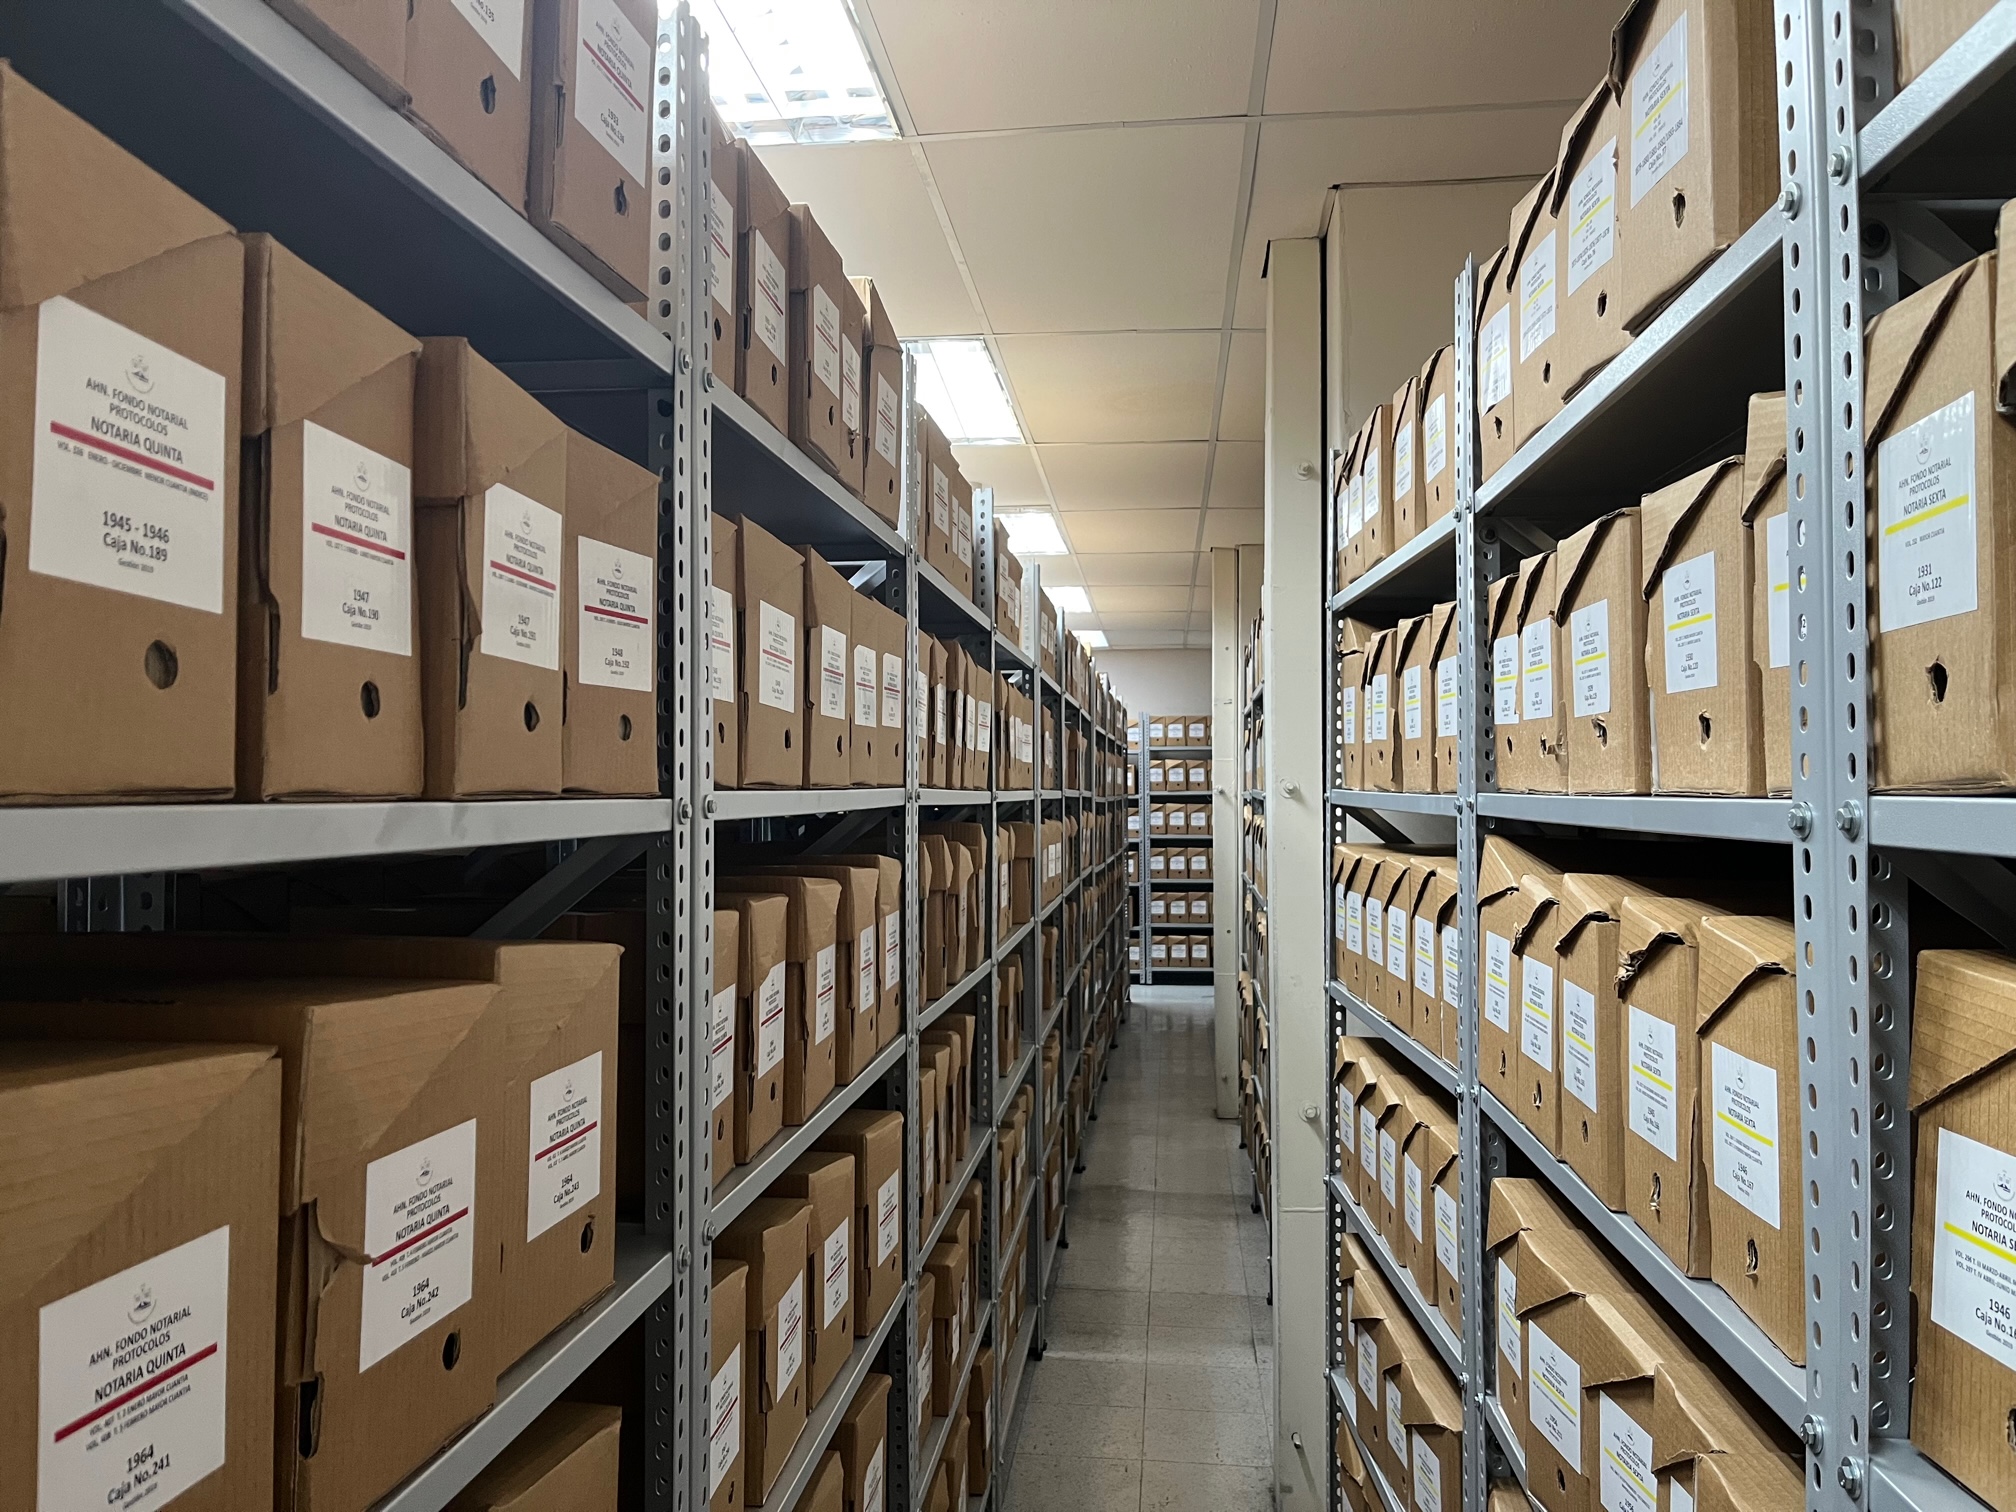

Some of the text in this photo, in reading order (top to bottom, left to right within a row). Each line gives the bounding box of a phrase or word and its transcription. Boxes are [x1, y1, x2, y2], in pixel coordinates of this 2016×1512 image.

[86, 377, 189, 430] AHN. FONDO NOTARIAL
[109, 403, 169, 436] PROTOCOLOS
[91, 416, 184, 465] NOTARIA QUINTA
[1910, 468, 1927, 484] FONDO
[1927, 457, 1952, 476] NOTARIAL
[1909, 474, 1940, 497] PROTOCOLOS
[344, 502, 379, 522] PROTOCOLOS
[346, 491, 365, 506] FONDO
[366, 499, 390, 516] NOTARIAL
[1903, 488, 1947, 517] NOTARIA SEXTA
[103, 510, 132, 532] 1945
[143, 523, 170, 543] 1946
[334, 514, 388, 542] NOTARIA QUINTA
[103, 532, 168, 562] Caja No.189
[1917, 563, 1932, 579] 1931
[353, 588, 370, 603] 1947
[1908, 576, 1943, 598] Caja No.122
[342, 602, 356, 618] Caja
[549, 1126, 569, 1142] NOTARIA
[408, 1189, 428, 1207] FONDO
[428, 1177, 453, 1195] NOTARIAL
[561, 1173, 573, 1188] 1964
[406, 1193, 441, 1220] PROTOCOLOS
[553, 1191, 564, 1204] Caja
[1965, 1190, 1982, 1205] AHN.
[1983, 1197, 2008, 1216] FONDO
[395, 1204, 450, 1242] NOTARIA QUINTA
[1971, 1220, 2007, 1247] NOTARIA
[1981, 1208, 2016, 1233] PROTOCOL
[413, 1277, 430, 1297] 1964
[401, 1303, 415, 1319] Caja
[416, 1286, 439, 1310] No.242
[1989, 1298, 2012, 1320] 1946
[1975, 1307, 1993, 1326] Caja
[89, 1305, 191, 1367] AHN. FONDO NOTARIAL
[112, 1330, 171, 1370] PROTOCOLOS
[95, 1342, 186, 1404] NOTARIA QUINTA
[165, 1374, 189, 1392] CUANTIA
[168, 1384, 191, 1403] CUANTIA
[127, 1443, 154, 1474] 1964
[107, 1453, 170, 1505] Caja No.241
